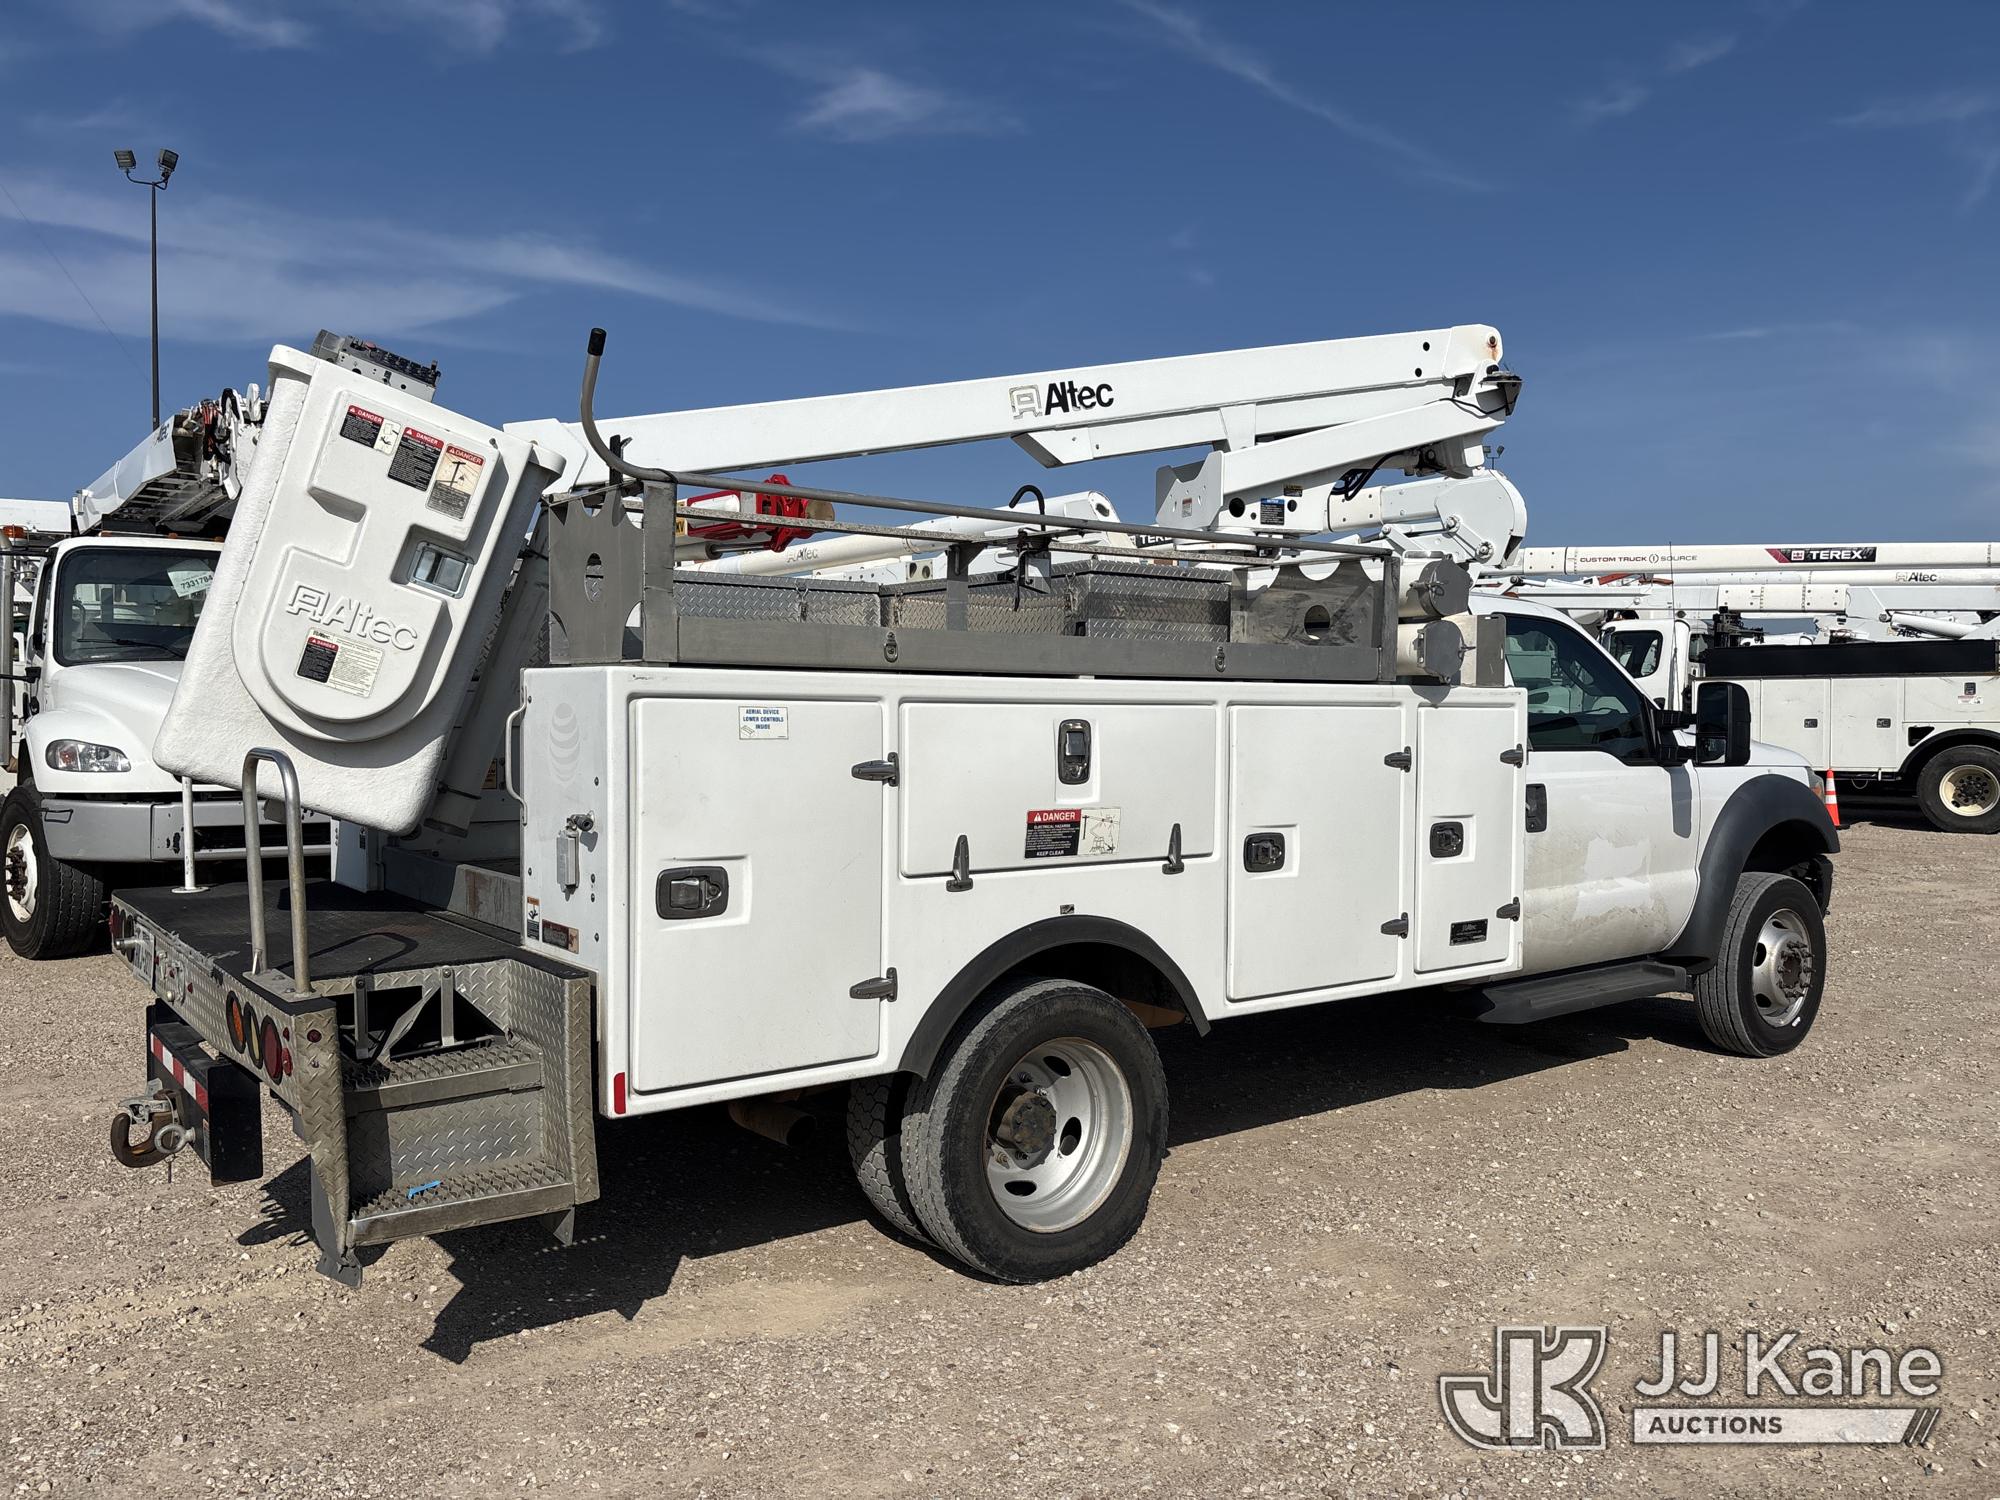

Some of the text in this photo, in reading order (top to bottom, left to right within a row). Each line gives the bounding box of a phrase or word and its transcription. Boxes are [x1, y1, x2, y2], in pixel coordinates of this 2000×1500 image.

[1045, 380, 1114, 416] Altec
[357, 410, 382, 423] DANGER
[416, 432, 438, 445] DANGER
[455, 449, 482, 465] DANGER
[1811, 550, 1863, 560] TEREX
[1908, 572, 1937, 582] Altec
[323, 596, 418, 651] Altec
[1042, 812, 1075, 821] DANGER
